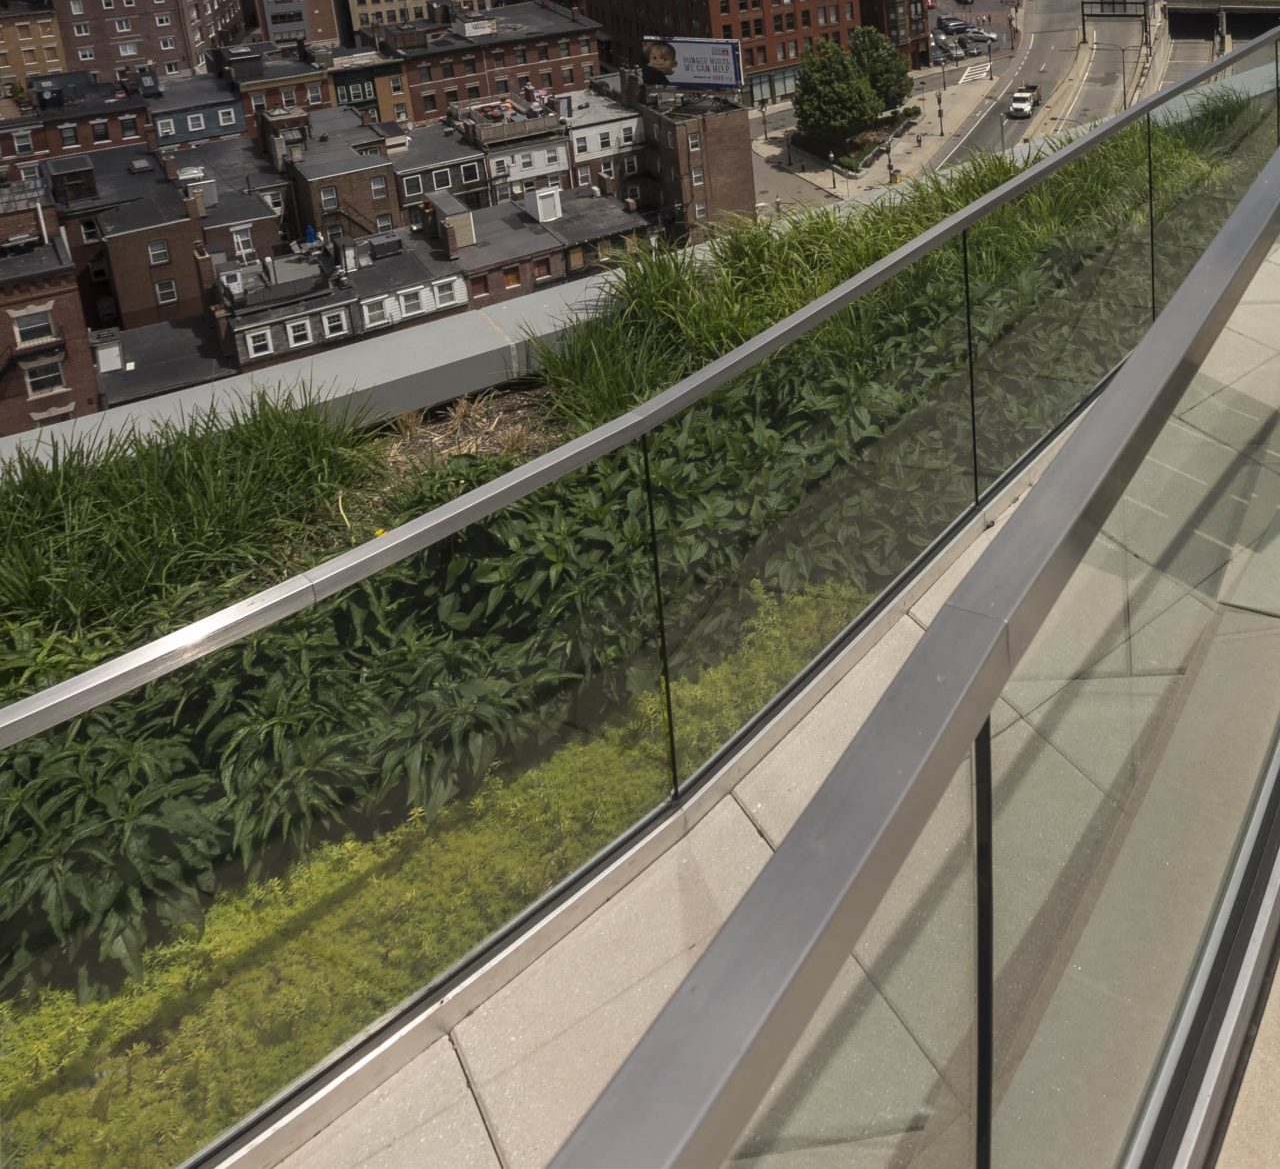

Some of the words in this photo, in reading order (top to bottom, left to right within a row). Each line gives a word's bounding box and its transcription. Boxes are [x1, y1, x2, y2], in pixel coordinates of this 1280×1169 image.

[683, 56, 708, 64] HUNGER
[684, 64, 695, 72] WE
[696, 64, 711, 72] CAN
